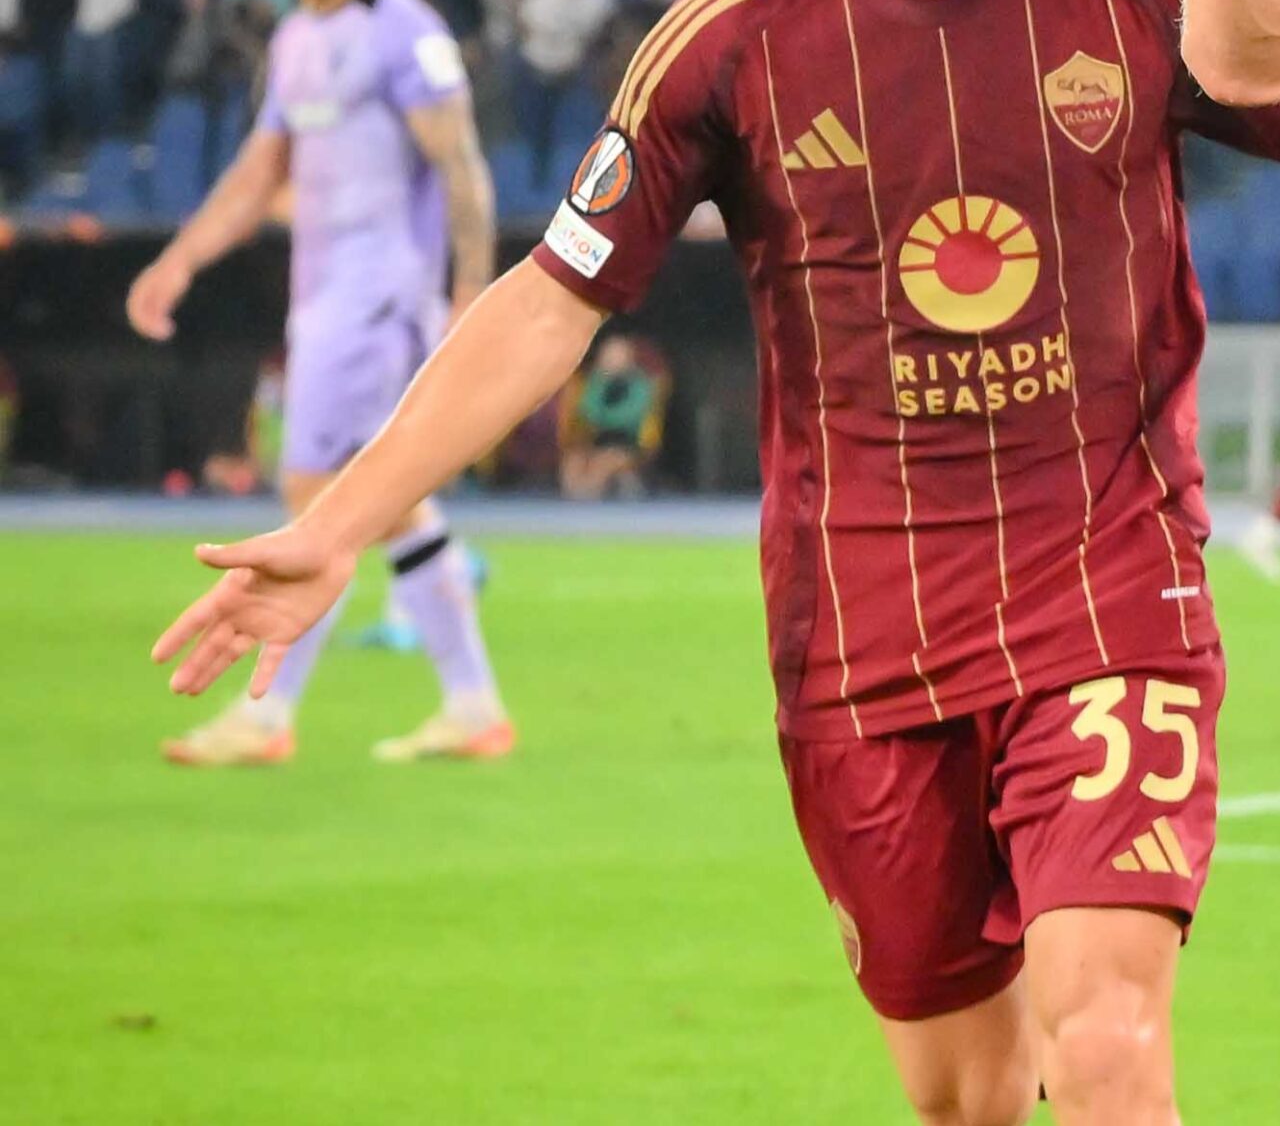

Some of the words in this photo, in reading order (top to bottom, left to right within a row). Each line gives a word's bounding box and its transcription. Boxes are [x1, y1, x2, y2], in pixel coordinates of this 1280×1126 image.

[1065, 106, 1112, 125] ROMA
[893, 333, 1066, 383] RIYADH
[899, 364, 1071, 417] SEASON
[1068, 676, 1201, 802] 35
